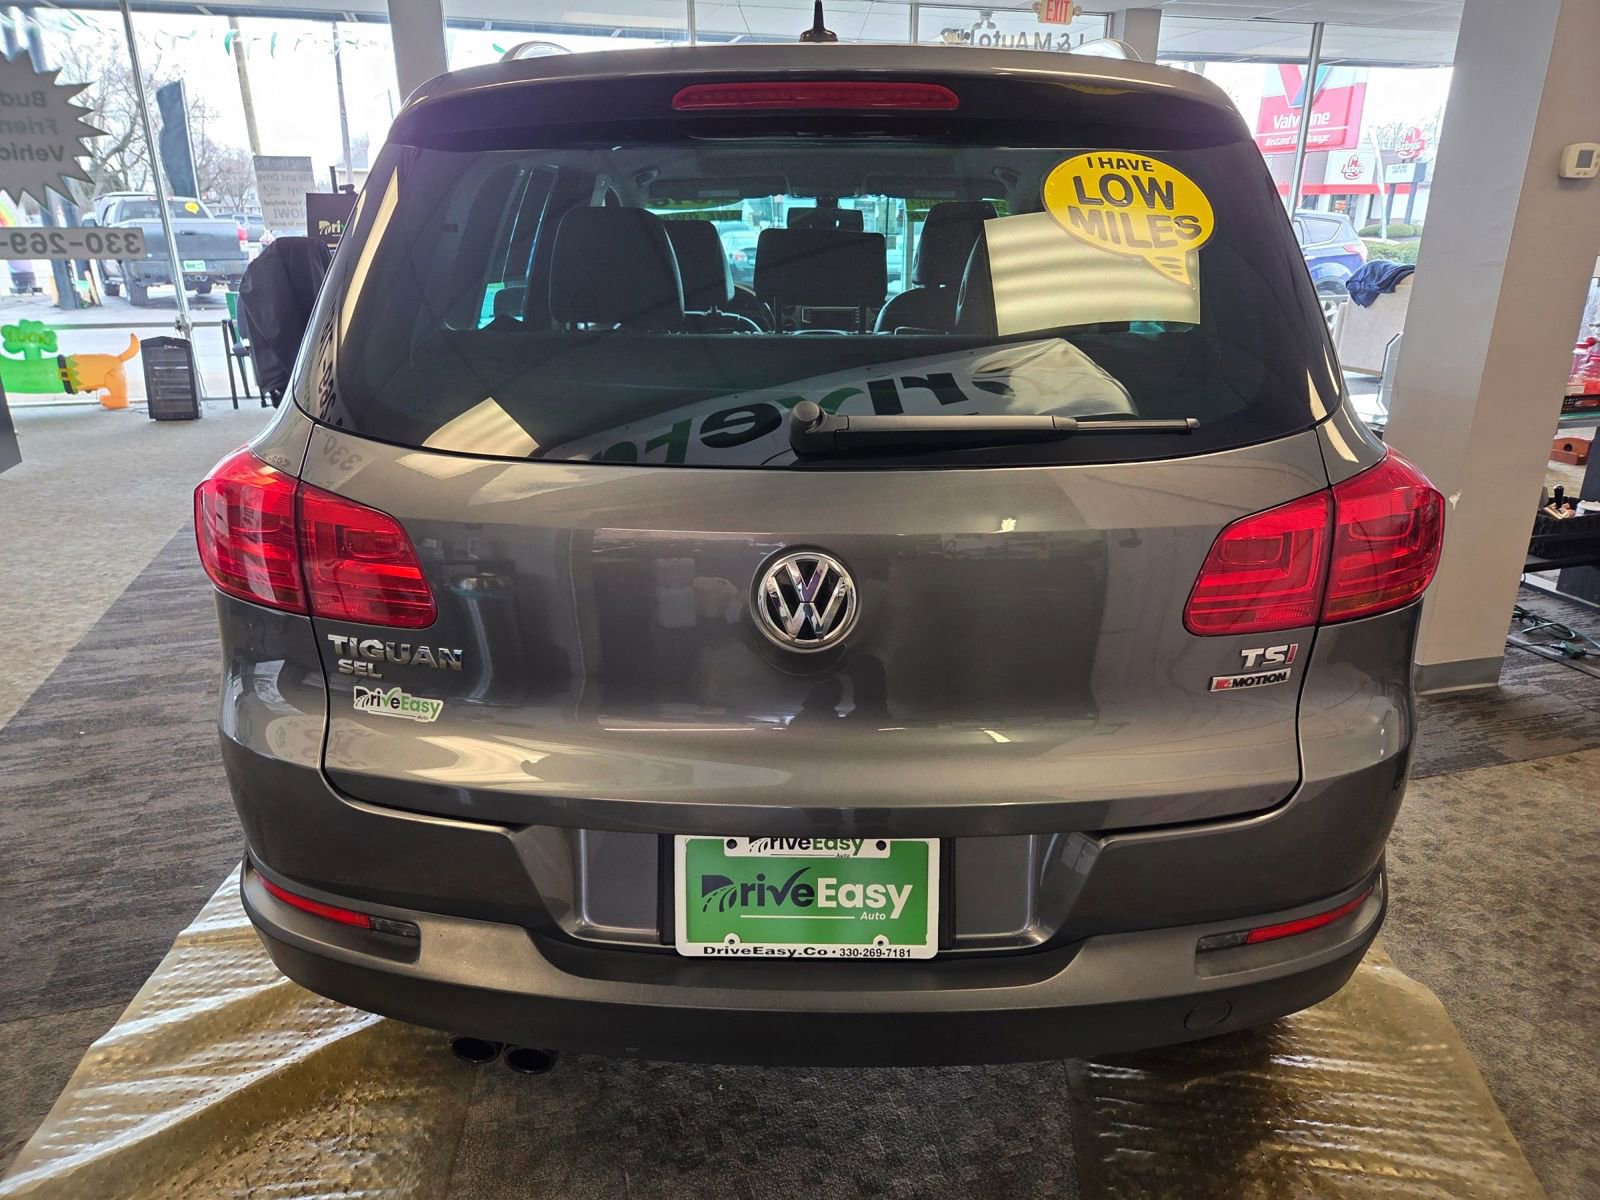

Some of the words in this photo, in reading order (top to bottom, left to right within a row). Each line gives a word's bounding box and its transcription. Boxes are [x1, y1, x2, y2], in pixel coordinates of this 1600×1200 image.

[1045, 0, 1070, 22] EXIT
[1273, 111, 1331, 130] Valvine
[1086, 156, 1094, 169] I
[1098, 157, 1155, 172] HAVE
[1072, 173, 1174, 211] LOW
[1067, 205, 1203, 249] MILES
[327, 633, 463, 671] TIGUAN
[338, 658, 383, 679] SEL
[355, 687, 441, 719] DriveEasy
[701, 867, 913, 919] DriveEasy
[860, 911, 886, 921] Auto
[703, 946, 828, 958] DriveEasy.Co
